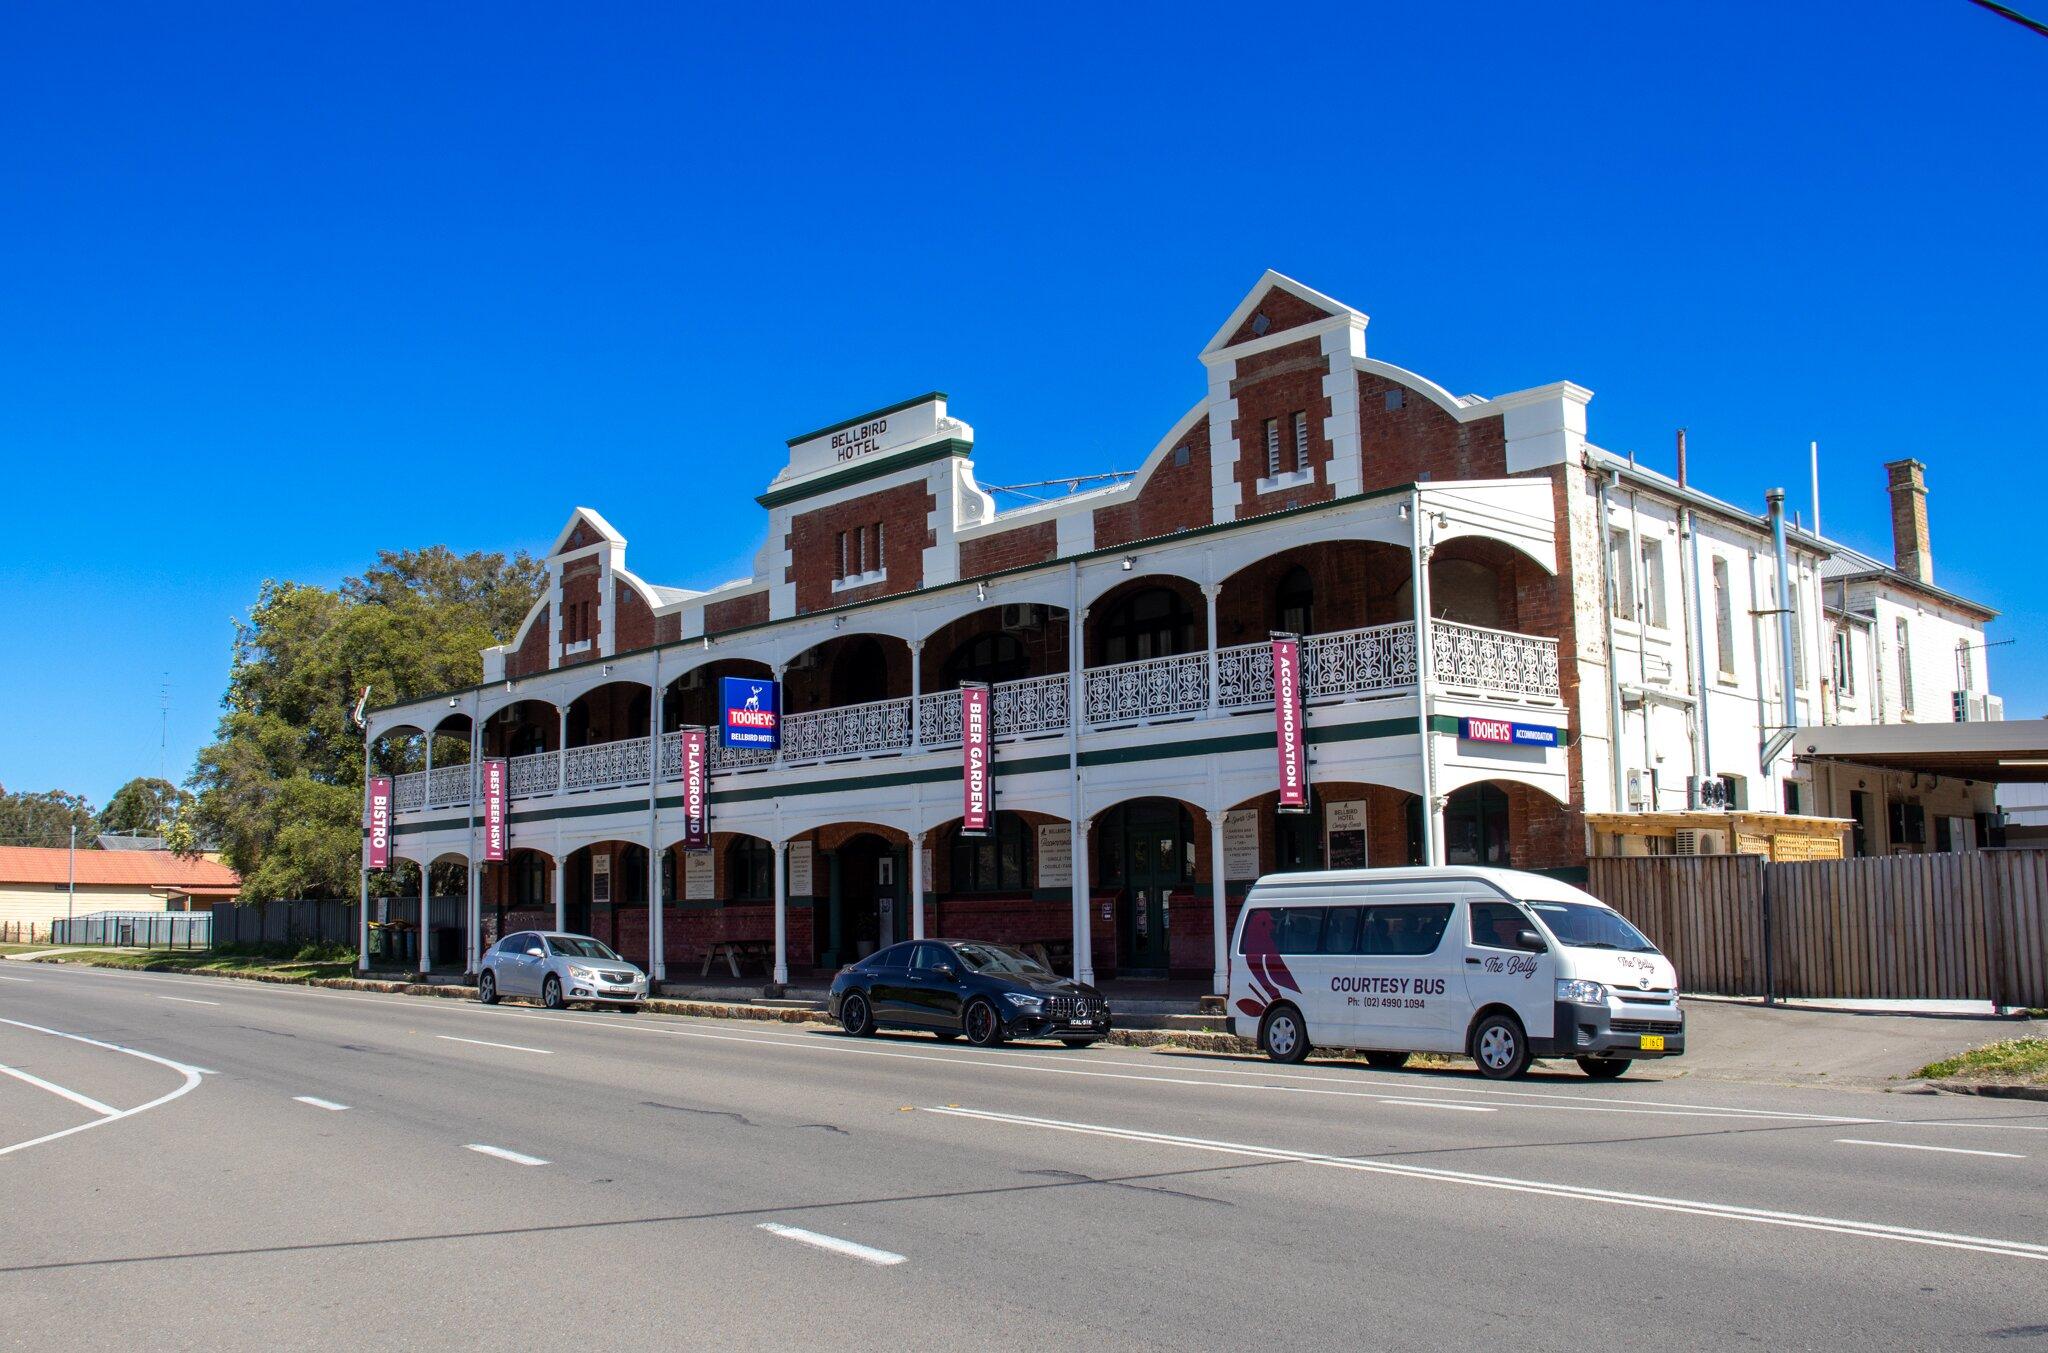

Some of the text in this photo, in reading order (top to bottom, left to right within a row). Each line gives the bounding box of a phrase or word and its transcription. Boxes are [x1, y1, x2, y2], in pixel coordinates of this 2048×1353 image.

[832, 420, 887, 449] BELLBIRD
[838, 439, 879, 461] HOTEL
[731, 711, 776, 726] TOOHEYS
[970, 703, 982, 743] BEER
[1281, 657, 1297, 787] ACCOMMODATION
[731, 733, 776, 742] BELLBIRD HOTEL
[1469, 720, 1554, 742] TOOHEYS ACCOMMODATION
[490, 770, 499, 795] BEST
[689, 743, 700, 834] PLAYGROUND
[970, 747, 983, 813] GARDEN
[373, 796, 387, 849] BISTRO
[490, 797, 500, 824] BEER
[1334, 808, 1359, 816] BELLBIRD
[490, 825, 501, 849] NSW
[1485, 955, 1538, 979] The Belly
[1331, 976, 1445, 995] COURTESY BUS
[1347, 997, 1425, 1009] Ph: (02) 4990 1094
